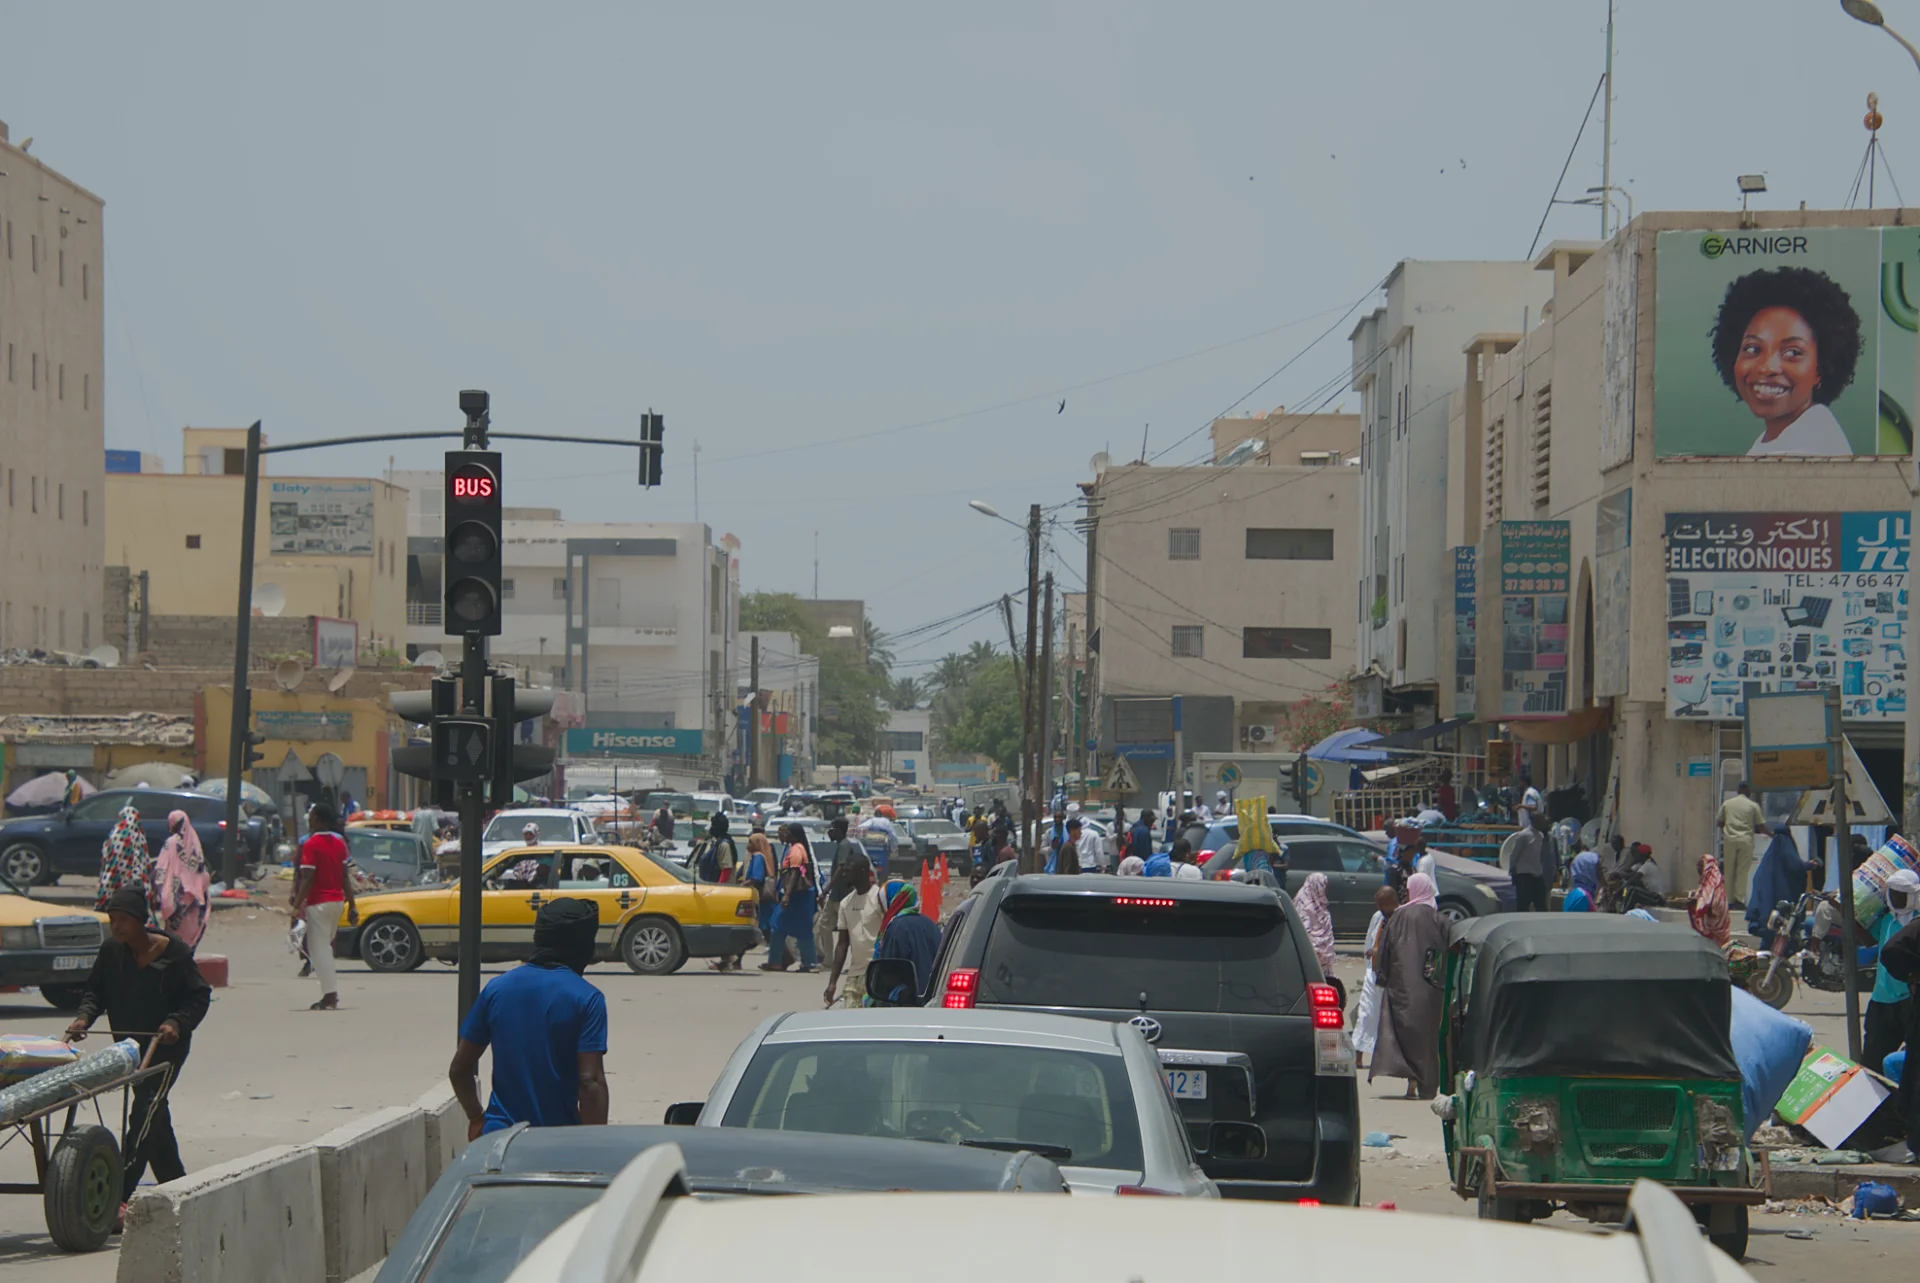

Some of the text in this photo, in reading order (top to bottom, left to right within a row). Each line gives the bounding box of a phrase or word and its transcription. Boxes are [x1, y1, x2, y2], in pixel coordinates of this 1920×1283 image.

[454, 477, 492, 497] BUS
[1670, 547, 1833, 570] ELECTRONIQUES
[1785, 574, 1815, 587] TEL
[1829, 574, 1850, 588] 47
[1856, 574, 1877, 588] 66
[1883, 574, 1905, 588] 47
[592, 732, 676, 748] Hisense
[1168, 1071, 1188, 1094] 12
